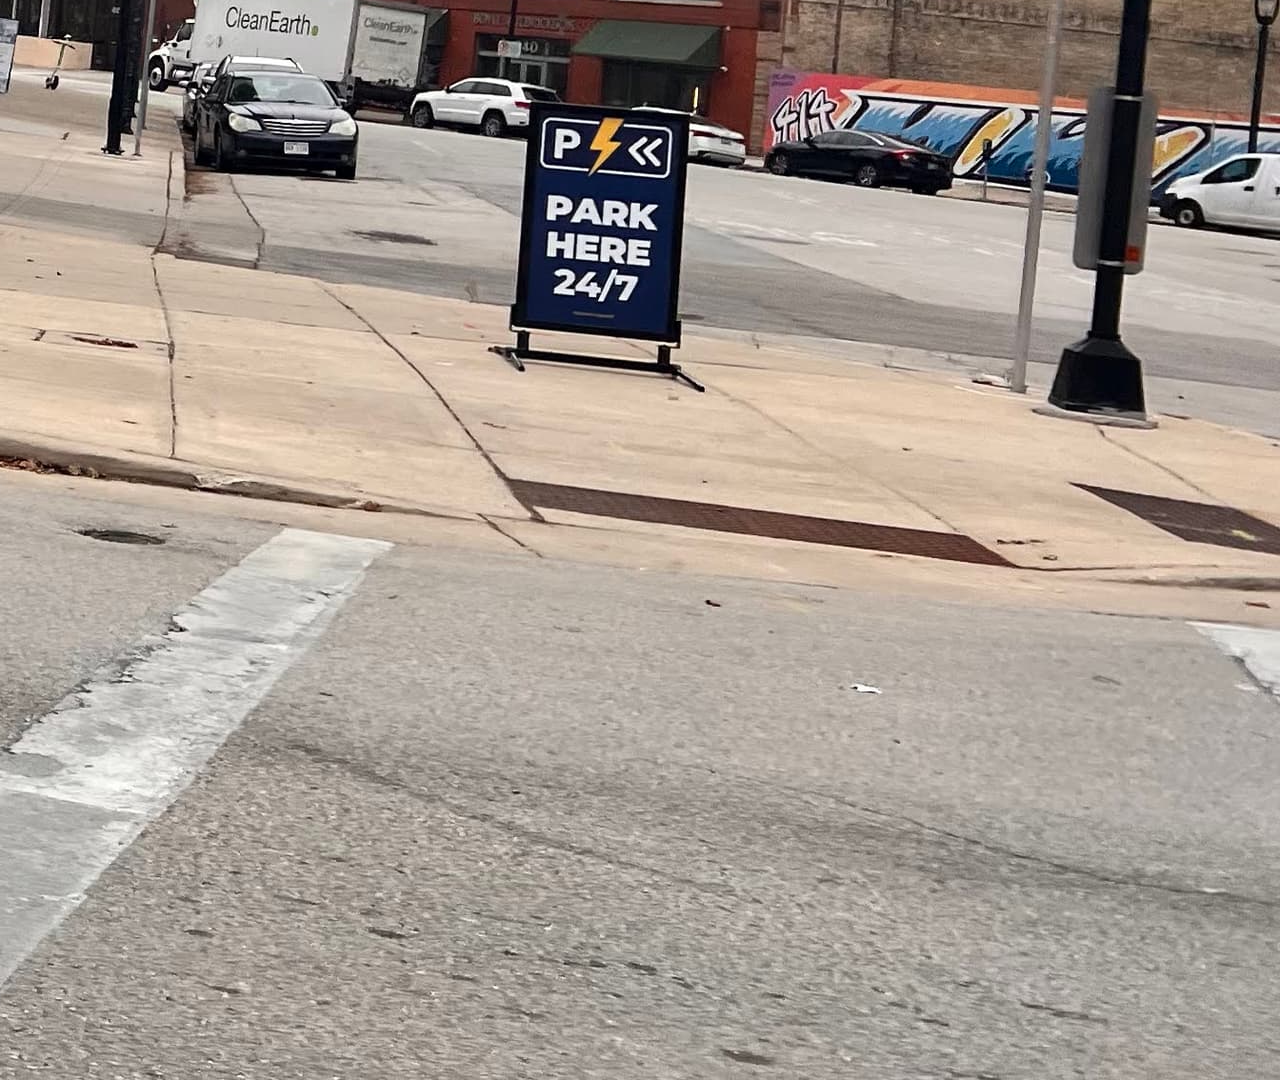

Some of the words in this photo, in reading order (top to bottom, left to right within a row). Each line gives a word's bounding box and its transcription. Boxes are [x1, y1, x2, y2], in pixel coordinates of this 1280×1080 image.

[553, 128, 581, 160] P
[546, 194, 659, 231] PARK
[546, 231, 652, 267] HERE
[553, 268, 639, 303] 24/7
